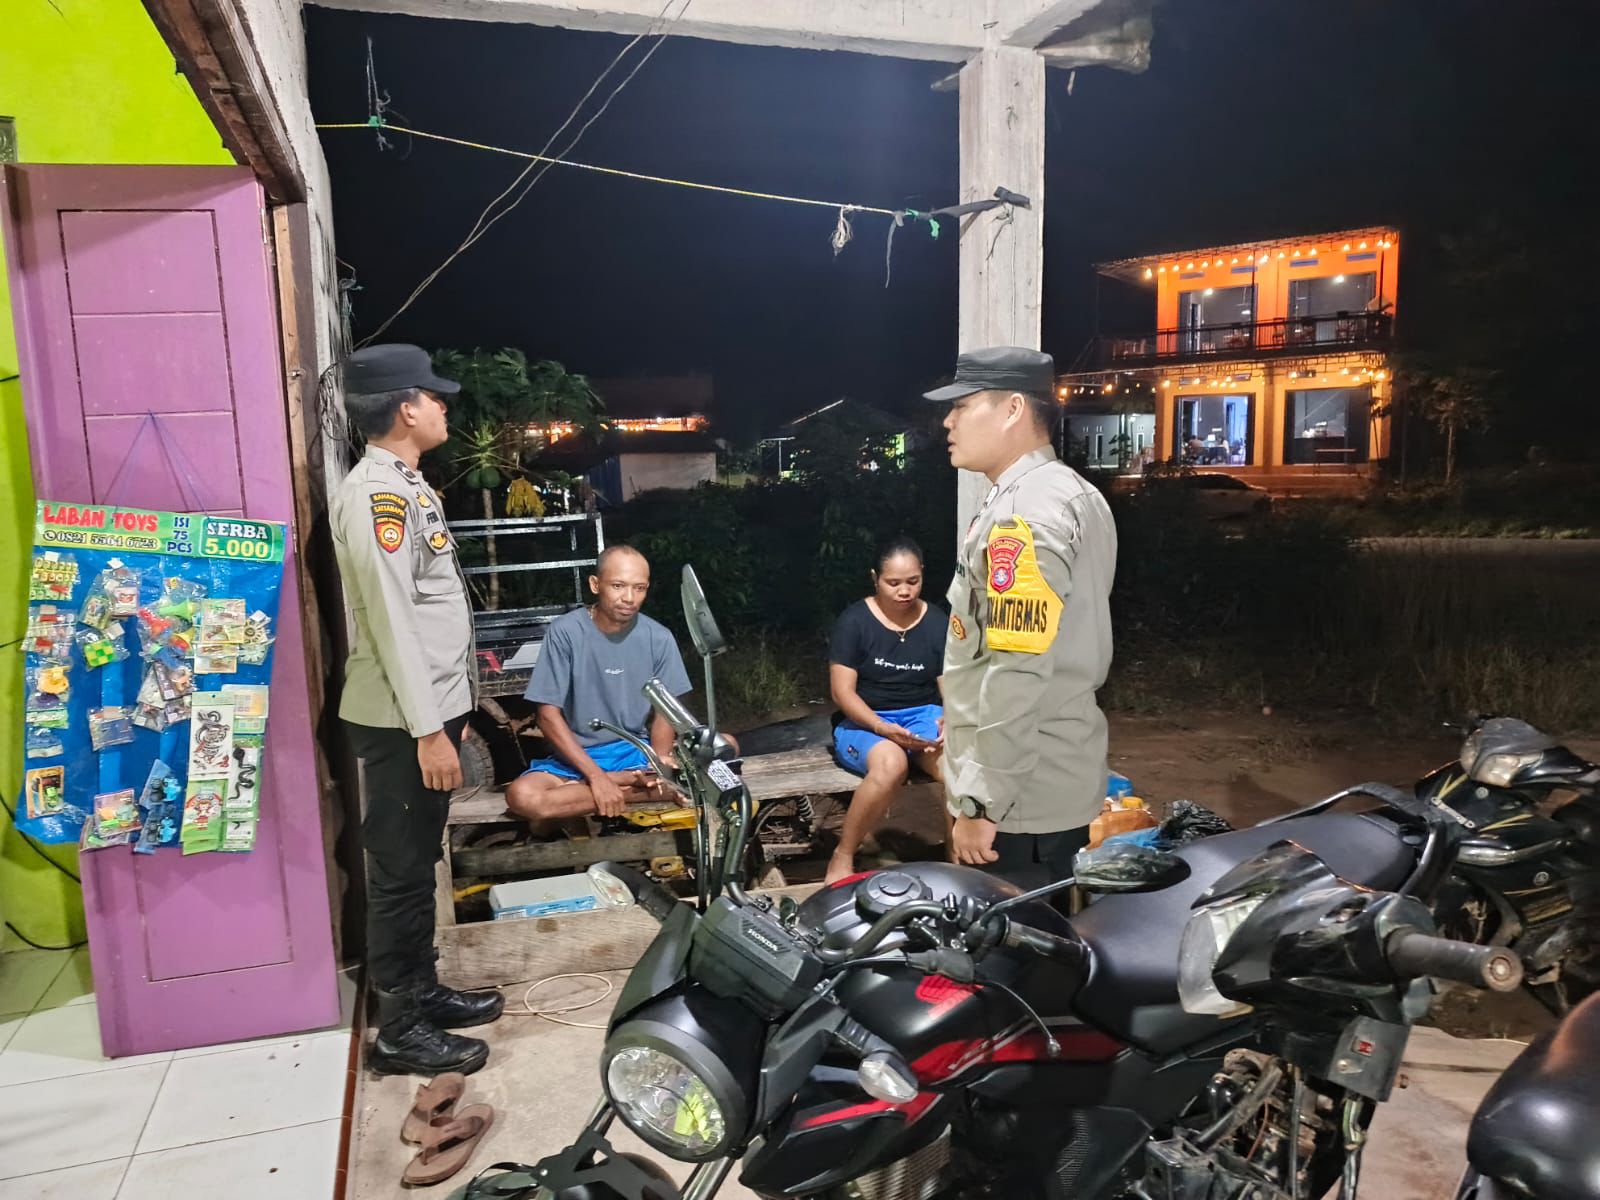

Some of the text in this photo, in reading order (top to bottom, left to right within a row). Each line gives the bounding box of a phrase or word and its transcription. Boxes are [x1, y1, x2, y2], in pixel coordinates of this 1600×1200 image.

[43, 505, 159, 532] LABAN TOYS
[174, 517, 190, 528] ISI
[173, 530, 188, 540] 75
[207, 522, 268, 539] SERBA
[167, 541, 192, 553] PCS
[205, 538, 269, 558] 5.000
[748, 929, 778, 951] HONDA
